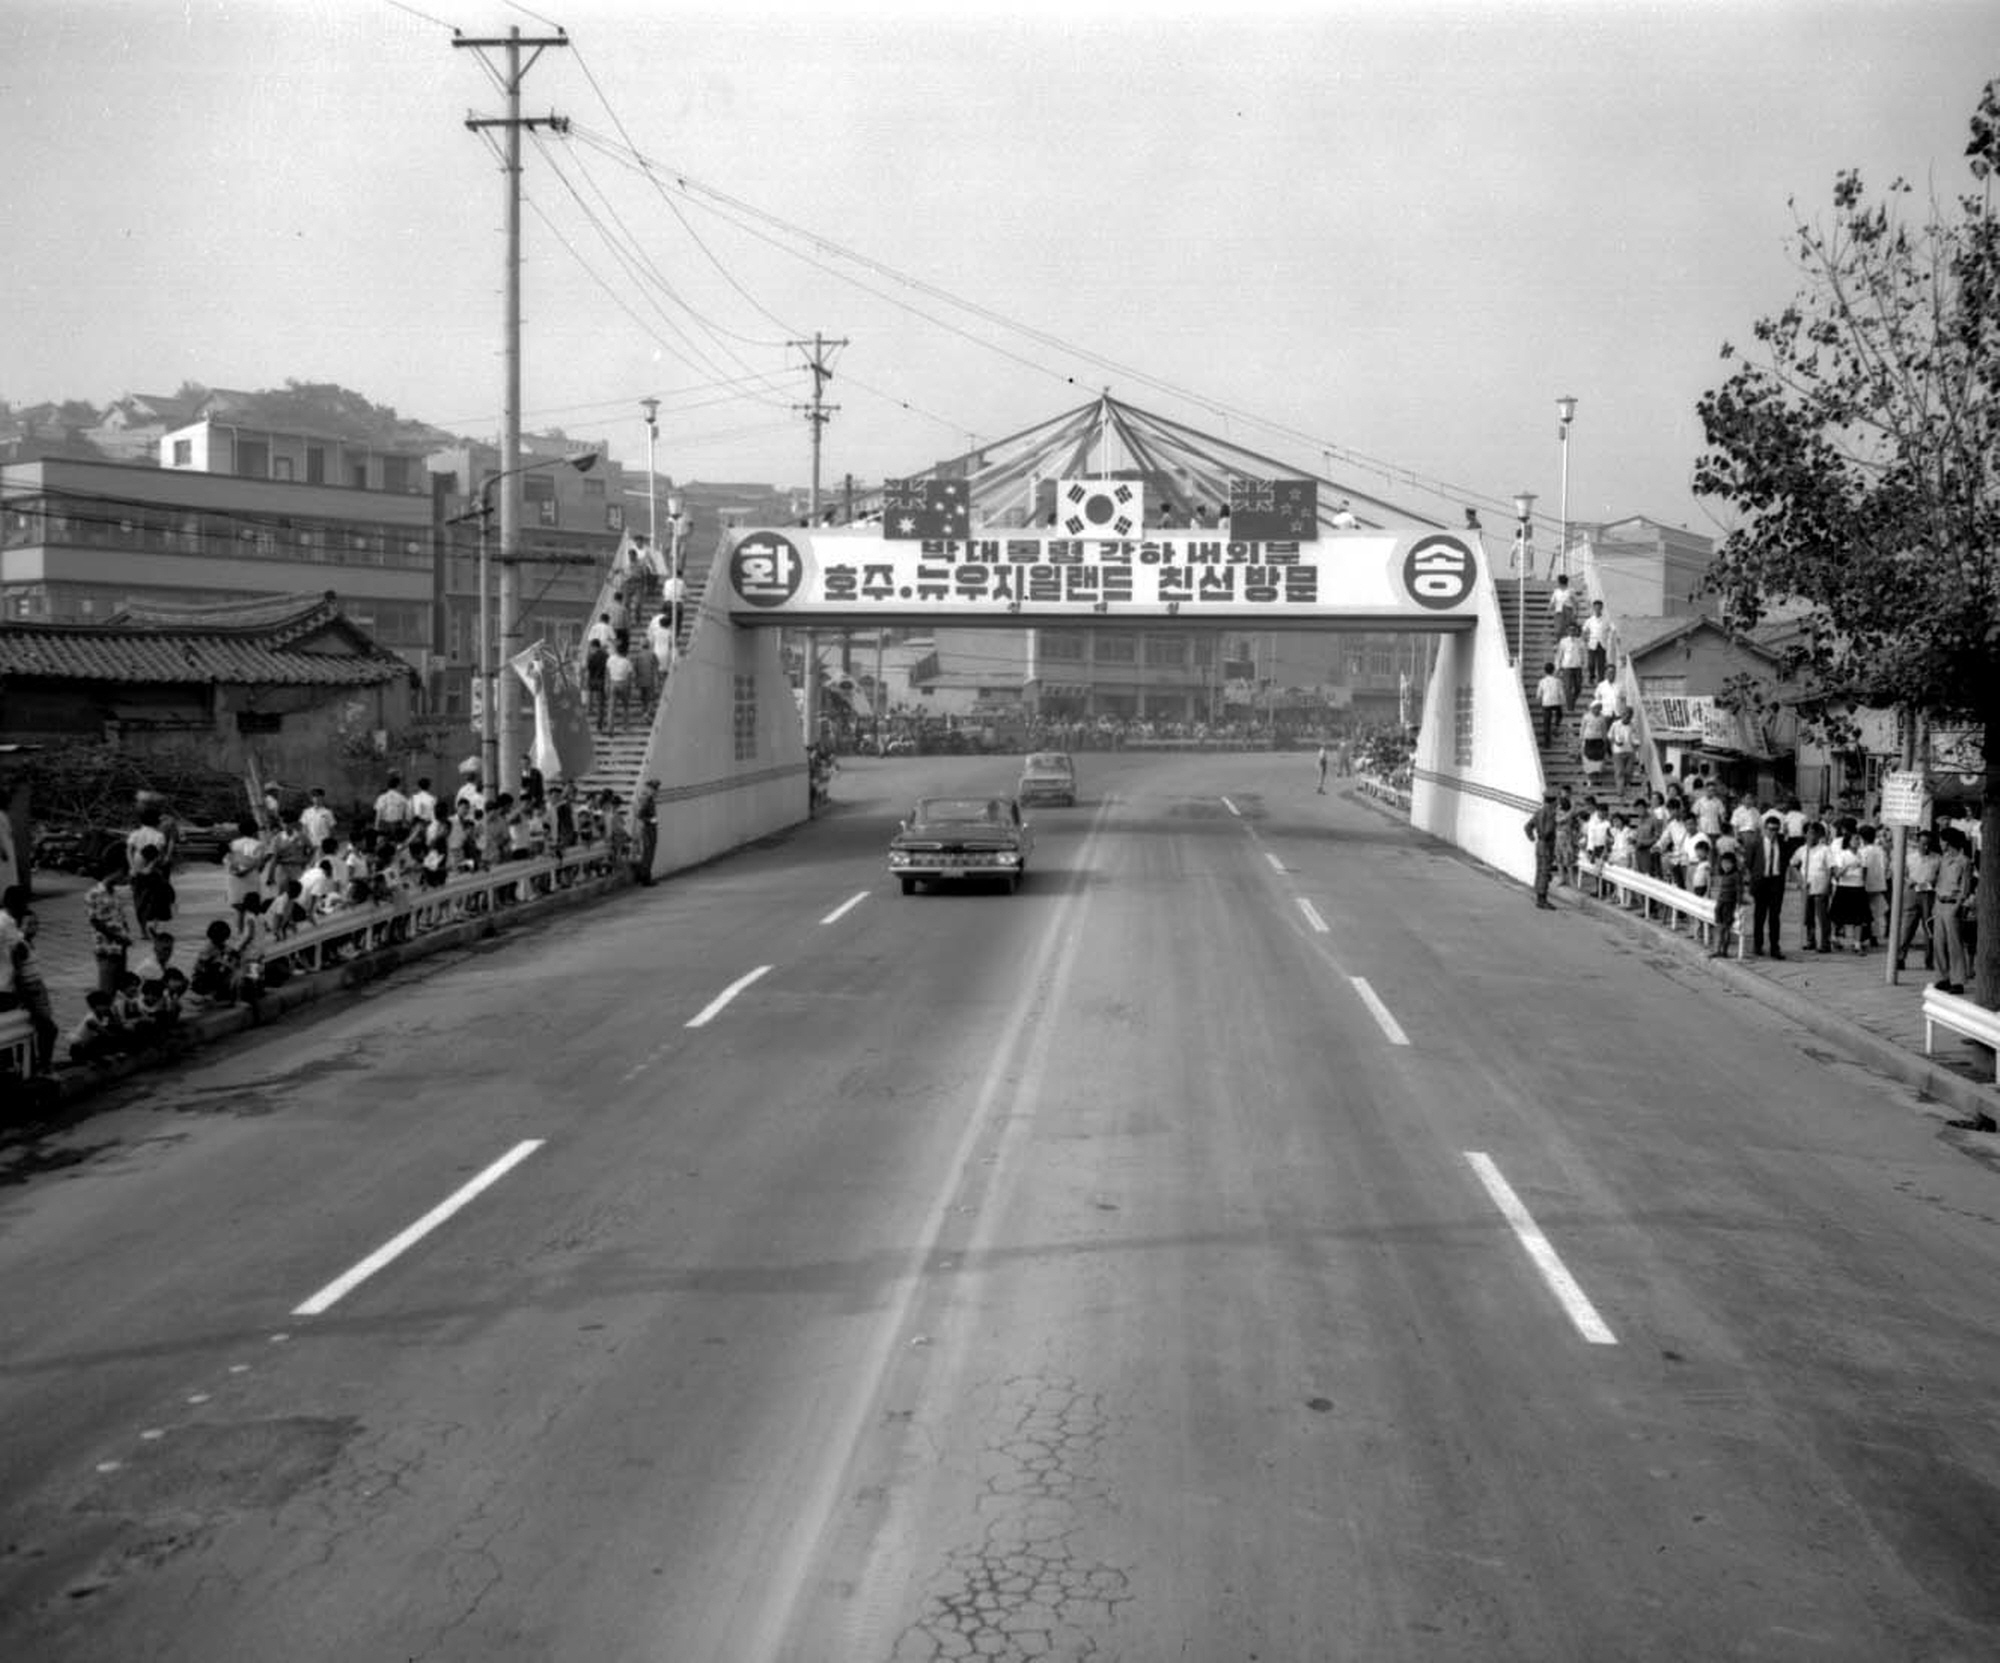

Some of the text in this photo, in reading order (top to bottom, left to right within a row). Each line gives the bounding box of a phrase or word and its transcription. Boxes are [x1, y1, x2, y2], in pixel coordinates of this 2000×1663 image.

[740, 543, 795, 595] 환
[921, 540, 1084, 564] 박대통령
[1099, 541, 1176, 564] 각하
[1414, 544, 1465, 597] 송
